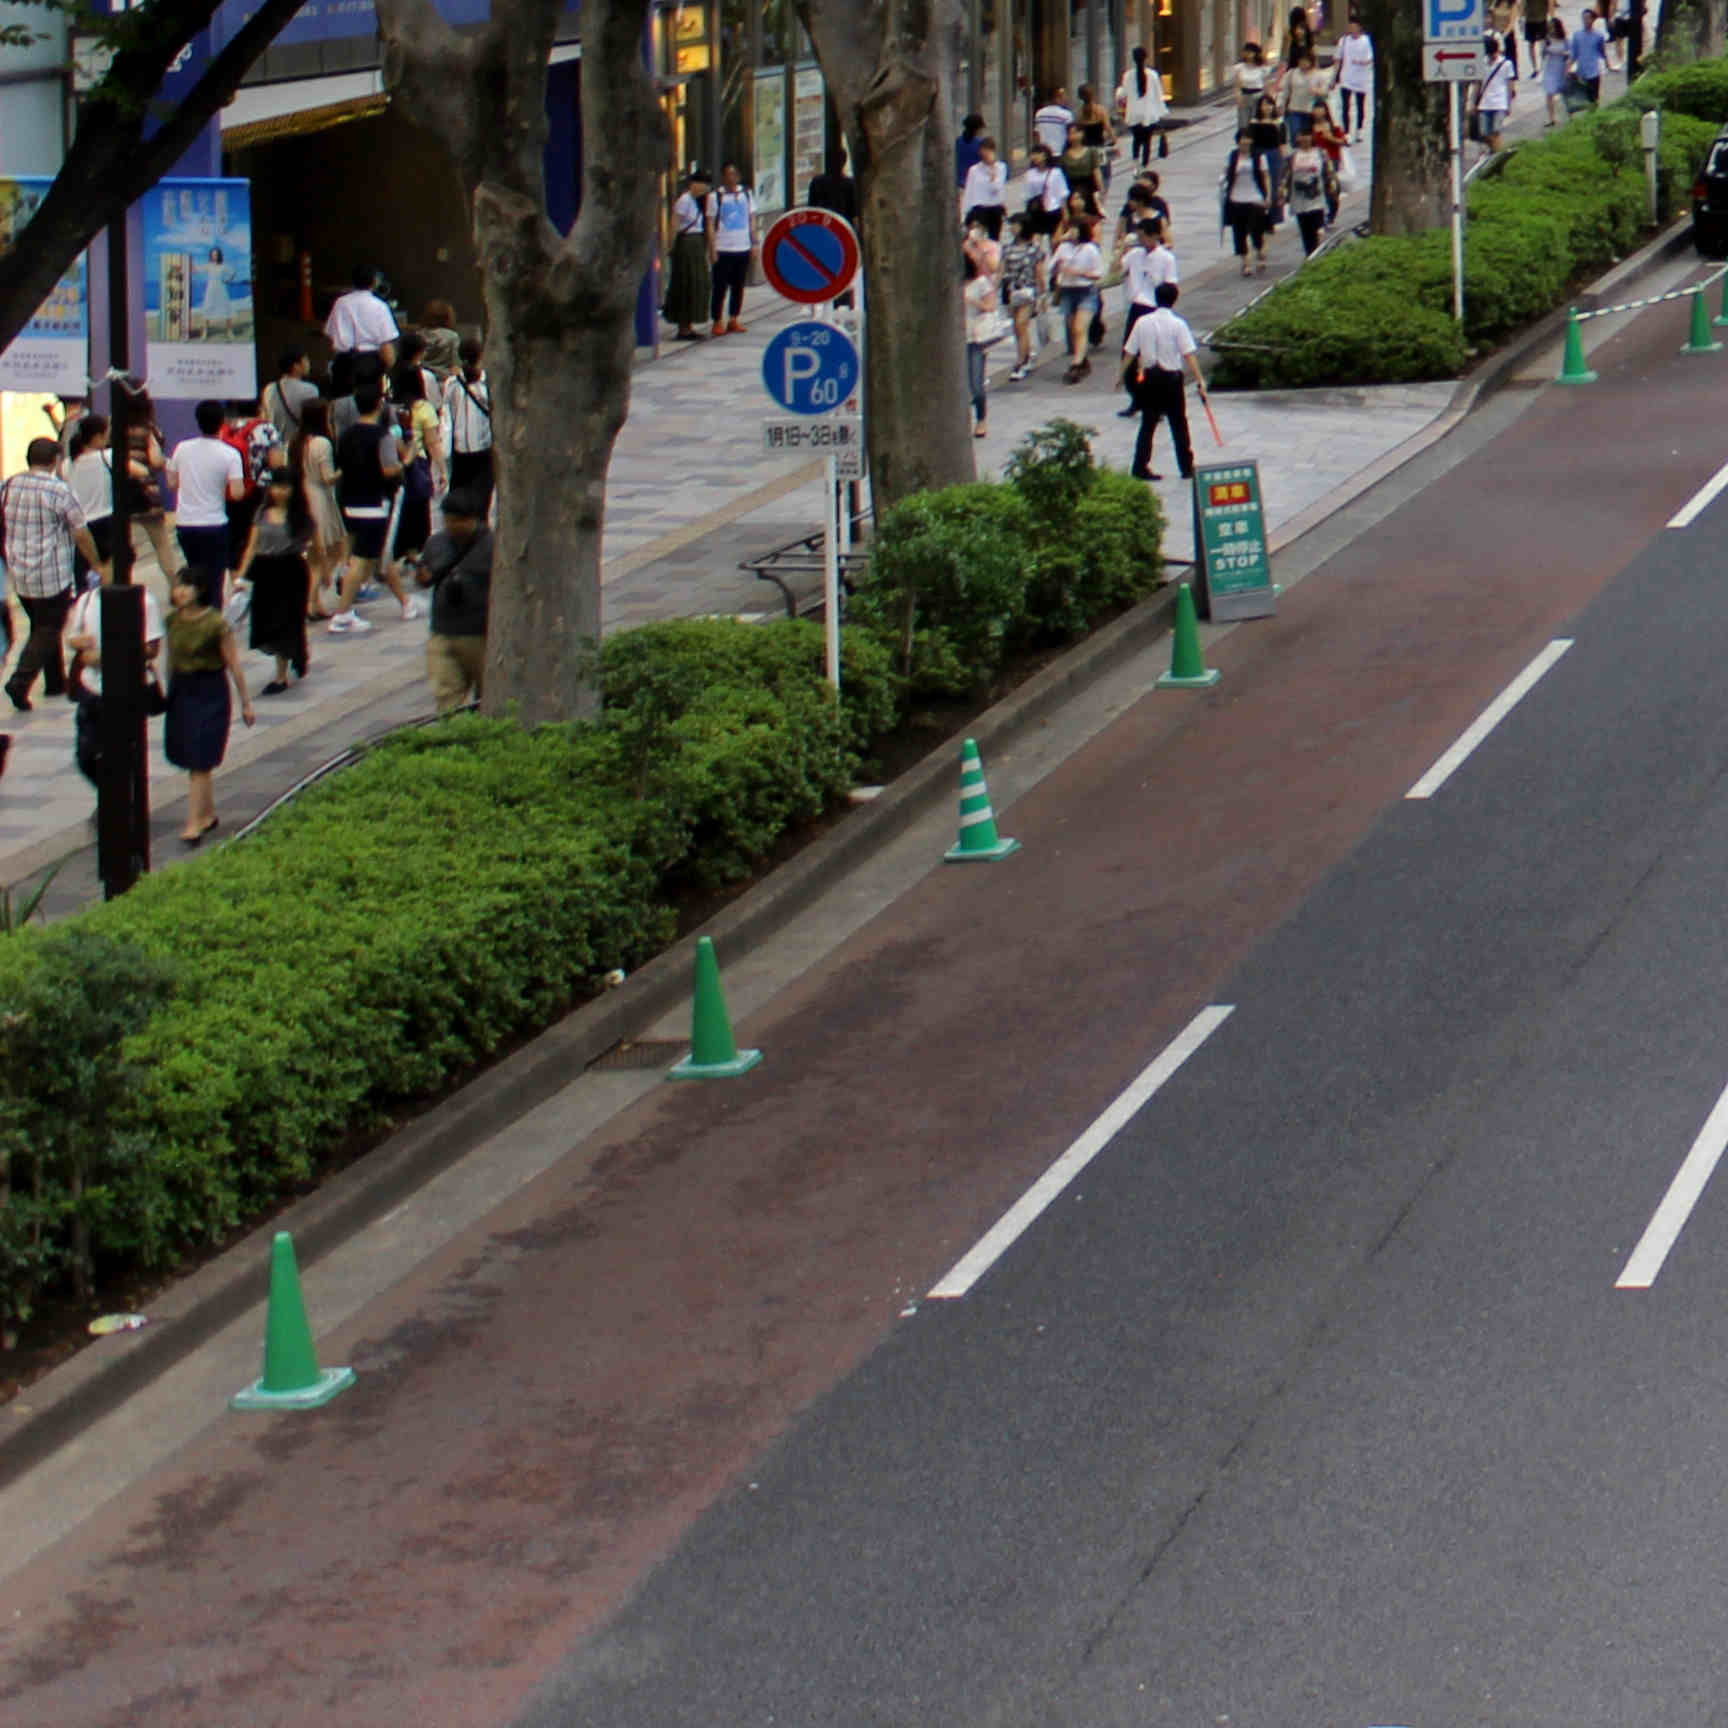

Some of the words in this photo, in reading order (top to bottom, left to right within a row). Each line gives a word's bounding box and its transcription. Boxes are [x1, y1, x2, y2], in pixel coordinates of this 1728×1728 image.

[784, 347, 821, 405] P
[811, 378, 839, 405] 60
[1216, 555, 1259, 571] STOP
